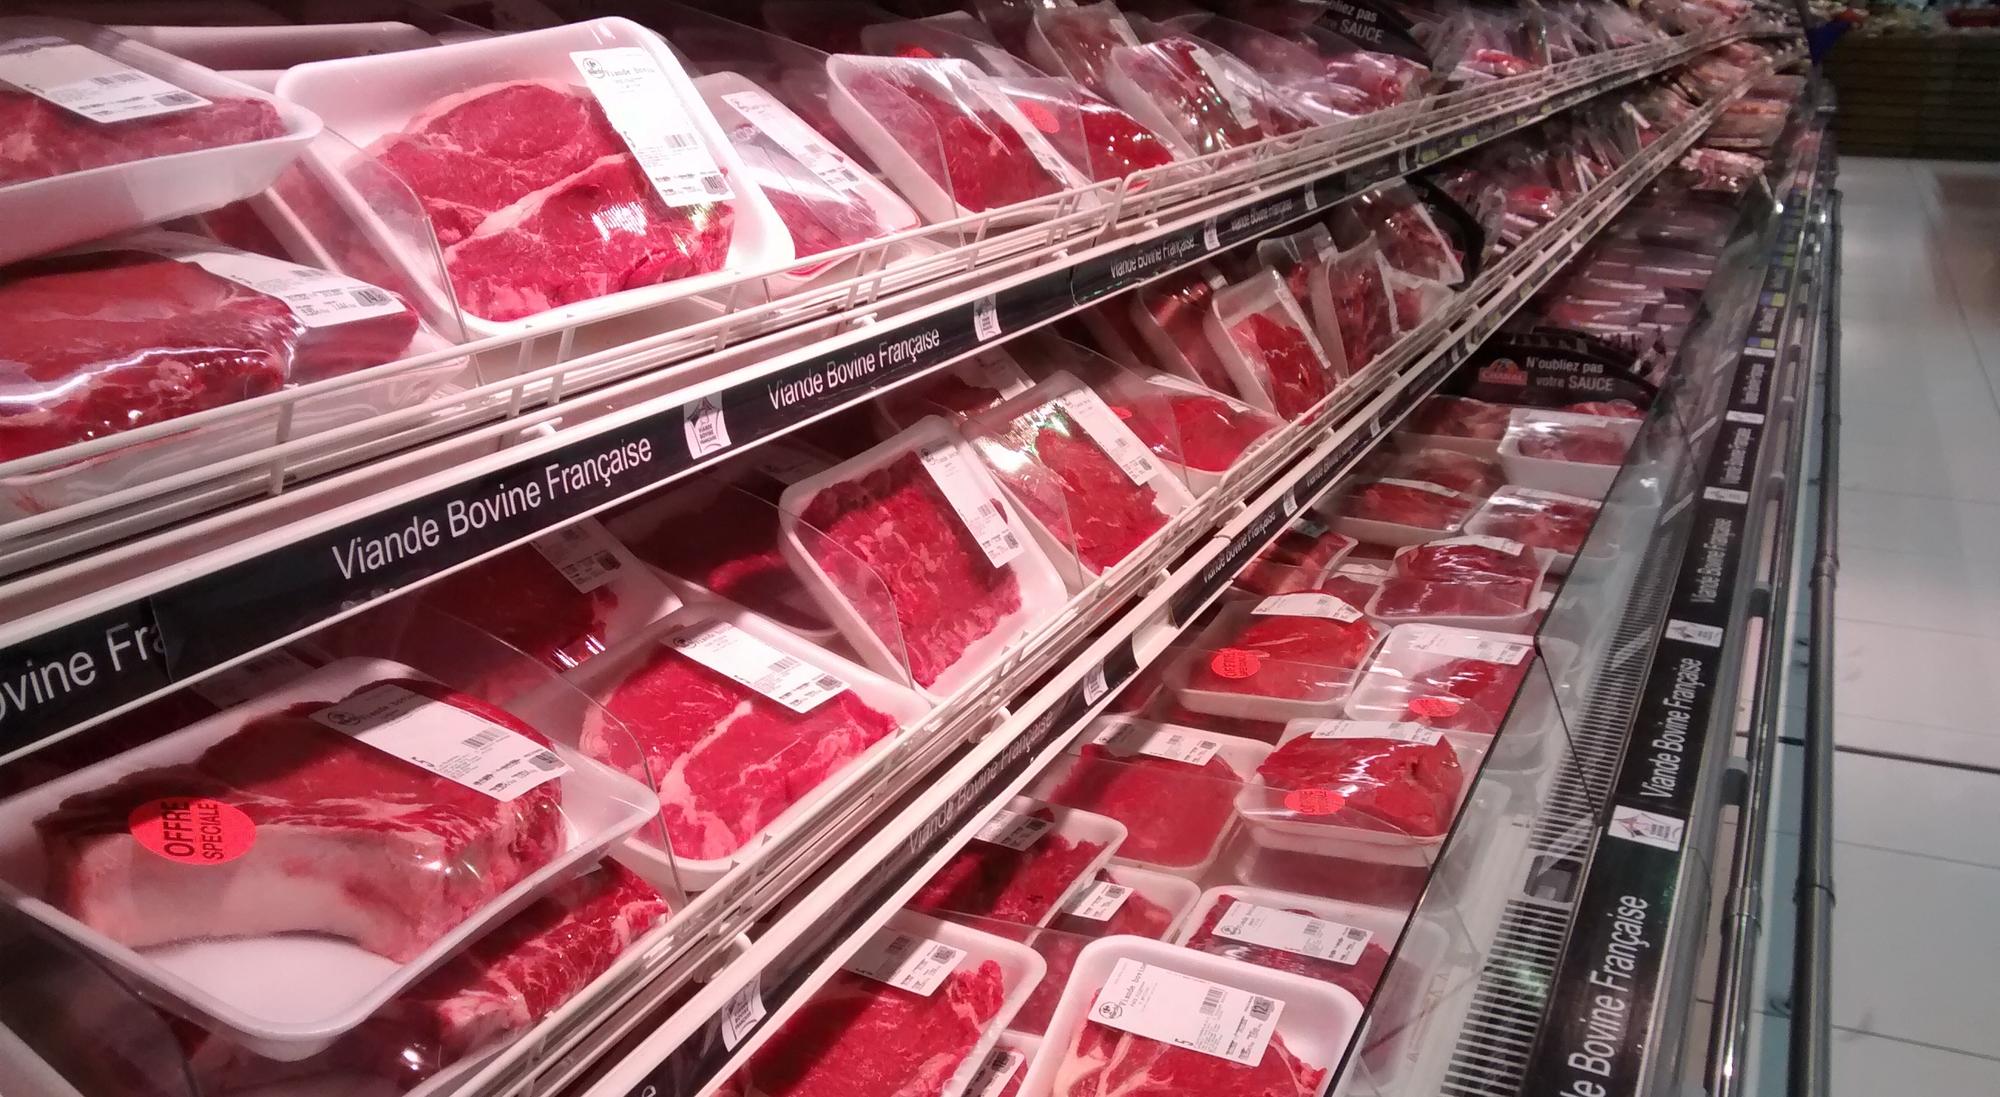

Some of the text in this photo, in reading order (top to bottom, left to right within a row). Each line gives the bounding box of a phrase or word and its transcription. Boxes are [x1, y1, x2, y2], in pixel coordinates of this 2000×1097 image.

[1340, 18, 1385, 44] SAUCE
[767, 327, 941, 411] Viande Bovine Française
[1526, 356, 1604, 374] N'oubliez pas
[1536, 375, 1616, 392] votre SAUCE
[331, 437, 653, 580] Viande Bovine Française
[1662, 656, 1706, 711] Française
[1652, 709, 1692, 753] Bovine
[908, 799, 954, 854] Viande
[957, 759, 998, 811] Bovine
[1000, 710, 1054, 769] Française
[1639, 752, 1682, 798] Viande
[161, 801, 195, 857] OFFRE
[197, 802, 225, 860] SPECIALE
[1558, 894, 1651, 1097] e Bovine Française
